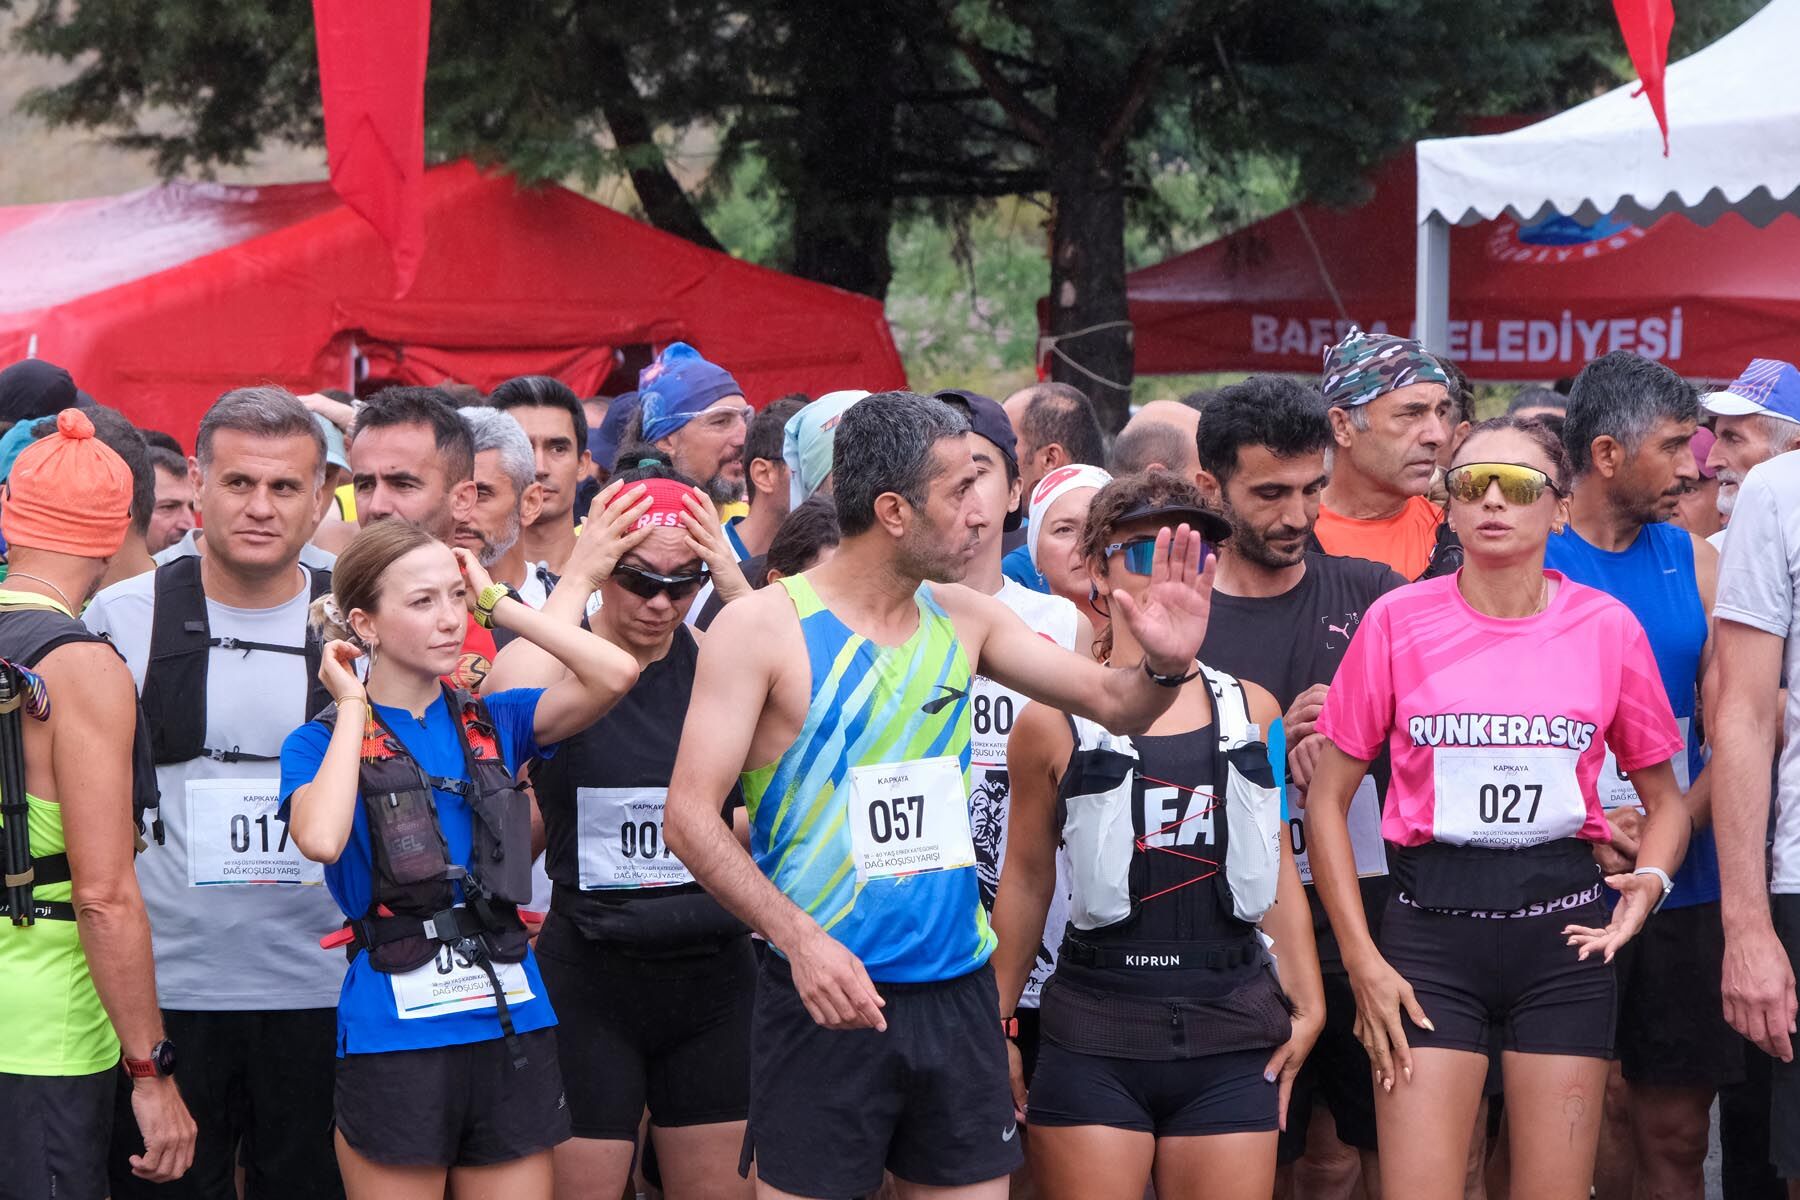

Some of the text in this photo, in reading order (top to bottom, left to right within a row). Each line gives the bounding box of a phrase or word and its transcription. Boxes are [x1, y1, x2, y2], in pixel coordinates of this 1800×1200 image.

[1410, 306, 1683, 362] ELEDİYESİ
[637, 511, 687, 529] RES
[1409, 713, 1597, 753] RUNKERASUS
[1479, 783, 1543, 823] 027
[868, 794, 924, 844] 057
[1144, 784, 1215, 850] EA
[230, 814, 290, 853] 017
[1489, 837, 1524, 846] KOŞUSU
[864, 852, 941, 869] DAĞ KOŞUSU YARIŞI
[223, 867, 301, 876] DAĞ KOŞUSU YARIŞI
[613, 871, 631, 879] DAĞ
[1125, 954, 1181, 967] KIPRUN
[432, 987, 451, 997] DAĞ
[451, 982, 484, 993] KOŞUSU
